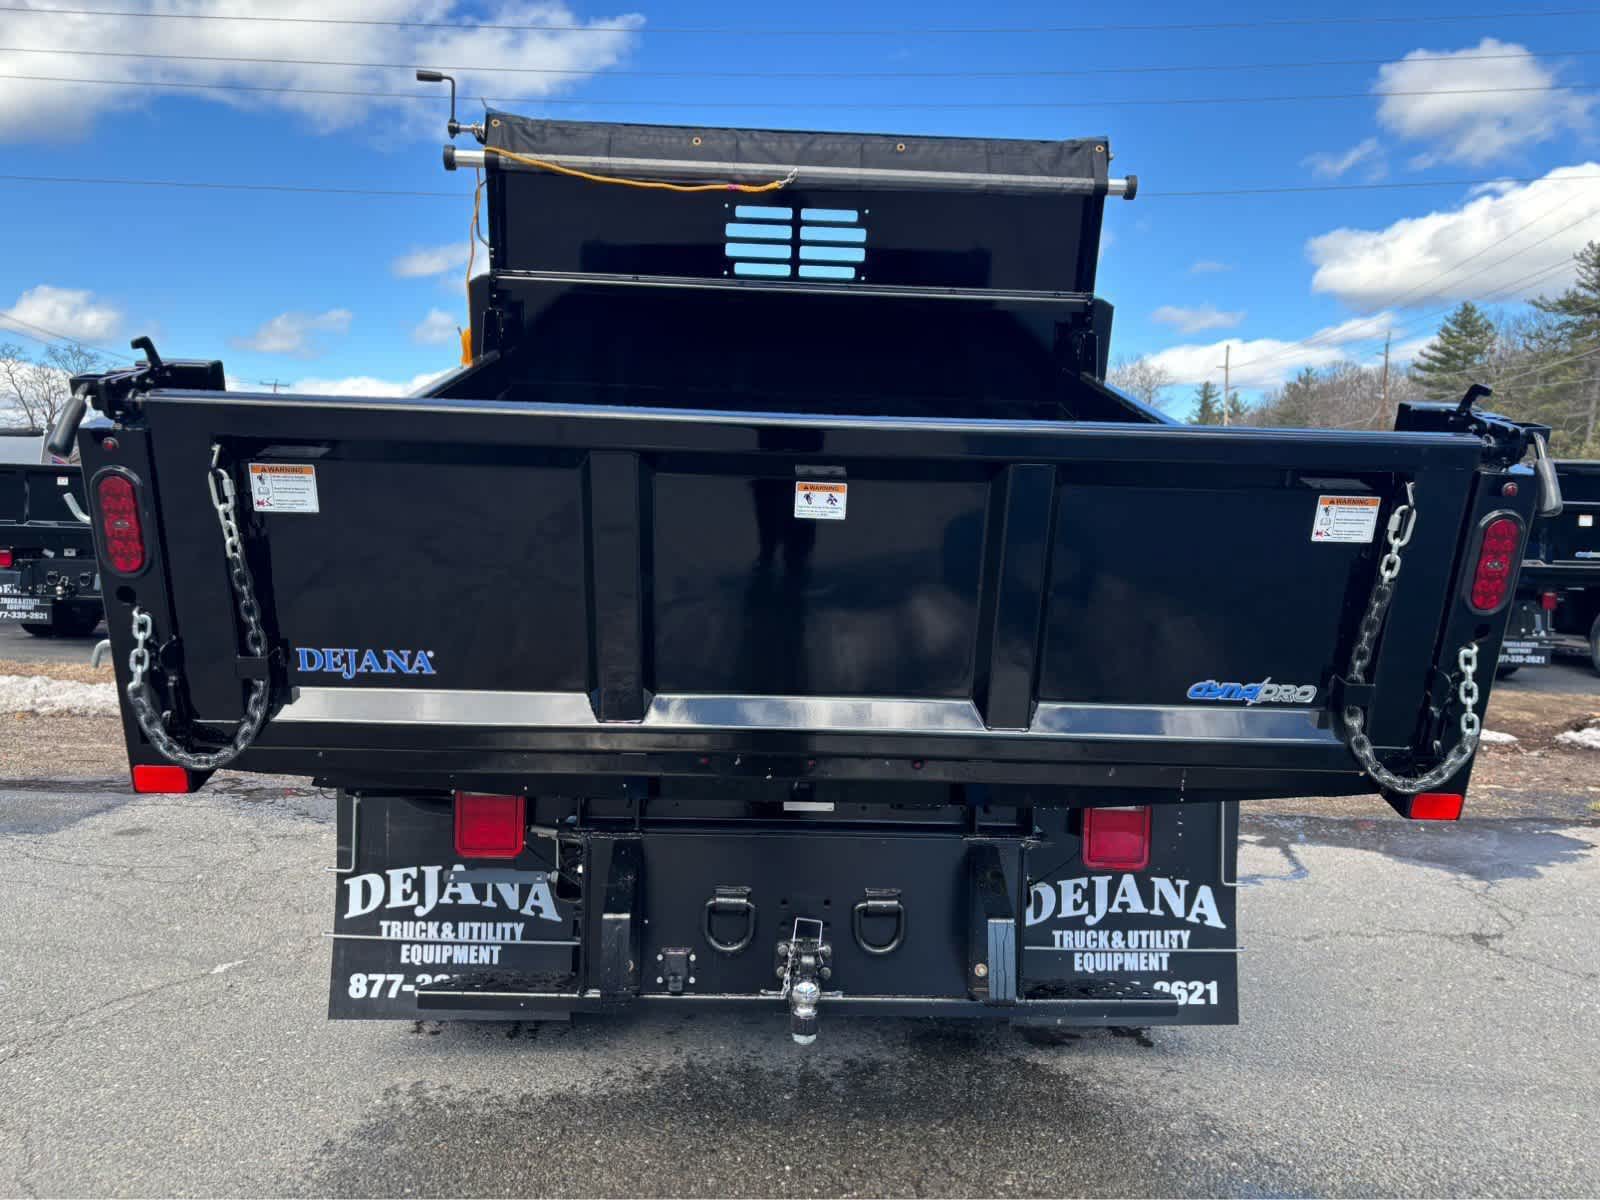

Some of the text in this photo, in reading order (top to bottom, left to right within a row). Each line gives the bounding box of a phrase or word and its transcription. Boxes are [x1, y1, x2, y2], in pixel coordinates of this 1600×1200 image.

[268, 465, 304, 474] WARNING
[809, 484, 840, 493] WARNING
[1336, 498, 1369, 506] WARNING
[295, 647, 437, 680] DEJANA
[343, 864, 562, 923] DEJANA
[1025, 873, 1227, 929] DEJANA
[400, 943, 502, 966] EQUIPMENT
[1073, 951, 1170, 974] EQUIPMENT
